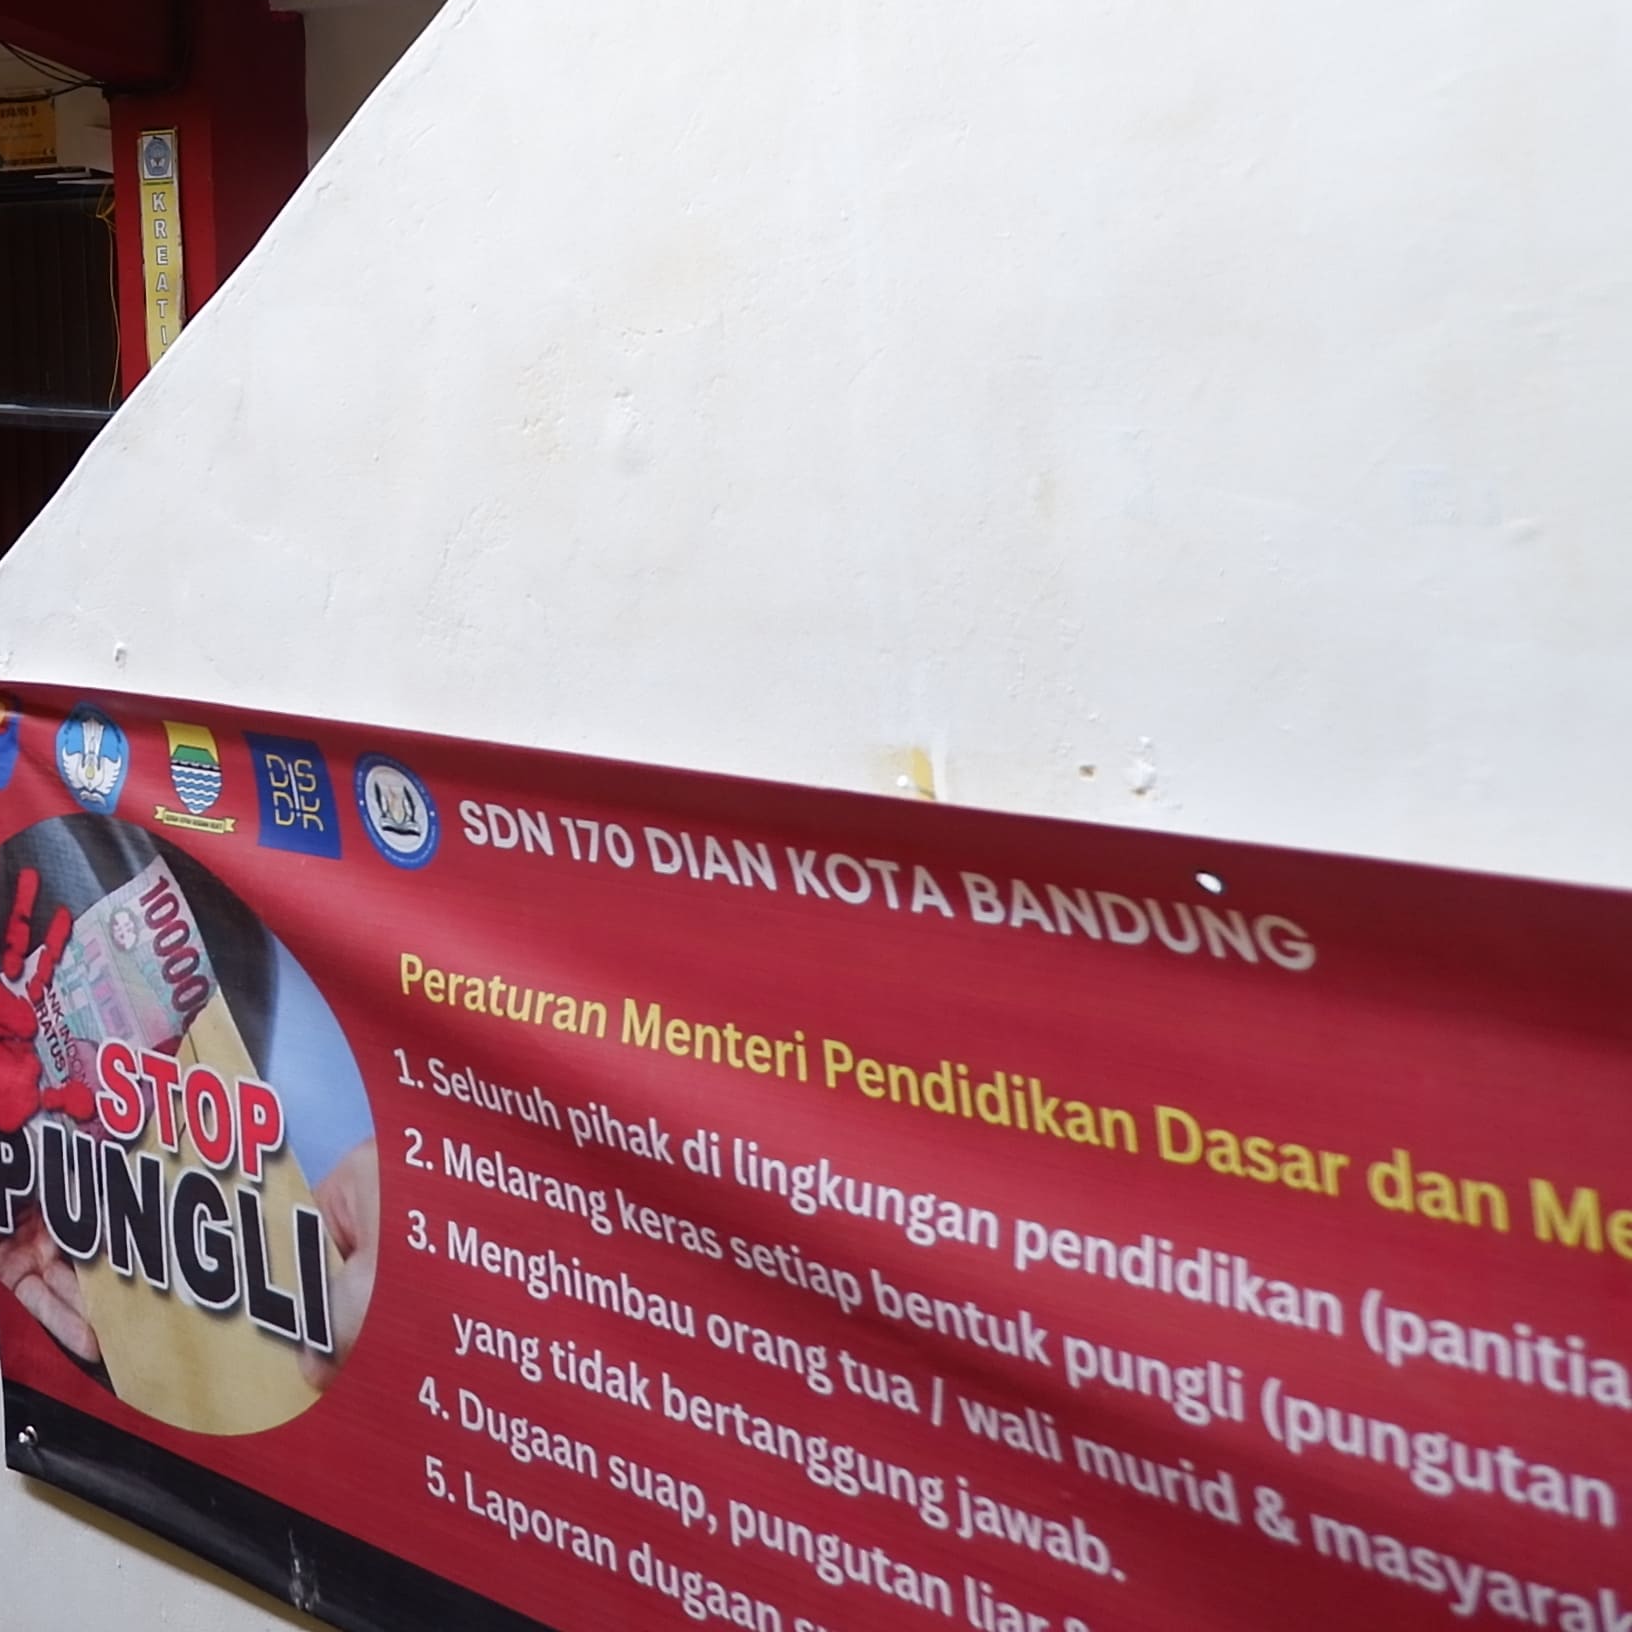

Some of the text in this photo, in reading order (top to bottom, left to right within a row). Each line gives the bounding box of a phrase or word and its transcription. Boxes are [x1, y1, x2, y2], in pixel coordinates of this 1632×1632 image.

[150, 191, 170, 356] KREATI
[459, 800, 554, 856] SDN
[560, 817, 635, 869] 170
[643, 827, 778, 892] DIAN
[785, 847, 954, 918] KOTA
[962, 871, 1318, 971] BANDUNG
[96, 1039, 284, 1182] STOP
[394, 1048, 424, 1089] 1.
[427, 1057, 562, 1131] Seluruh
[567, 1102, 675, 1166] pihak
[681, 1128, 722, 1180] di
[733, 1137, 1000, 1250] lingkungan
[1013, 1217, 1345, 1336] pendidikan
[399, 953, 607, 1038] Peraturan
[620, 997, 809, 1082] Menteri
[822, 1037, 1139, 1154] Pendidikan
[1154, 1105, 1351, 1197] Dasar
[1367, 1148, 1509, 1233] dan
[403, 1127, 1618, 1530] 2. Melarang keras setiap bentuk pungli (pungutan
[406, 1209, 437, 1254] 3.
[446, 1219, 696, 1339] Menghimbau
[705, 1312, 834, 1396] orang
[837, 1350, 920, 1414] tua
[957, 1394, 1063, 1464] wali
[1072, 1431, 1243, 1527] murid
[1252, 1484, 1302, 1547] &
[453, 1312, 1128, 1584] yang tidak bertanggung jawab.
[418, 1376, 1051, 1632] 4. Dugaan suap, pungutan liar
[424, 1455, 783, 1632] 5. Laporan dugaan
